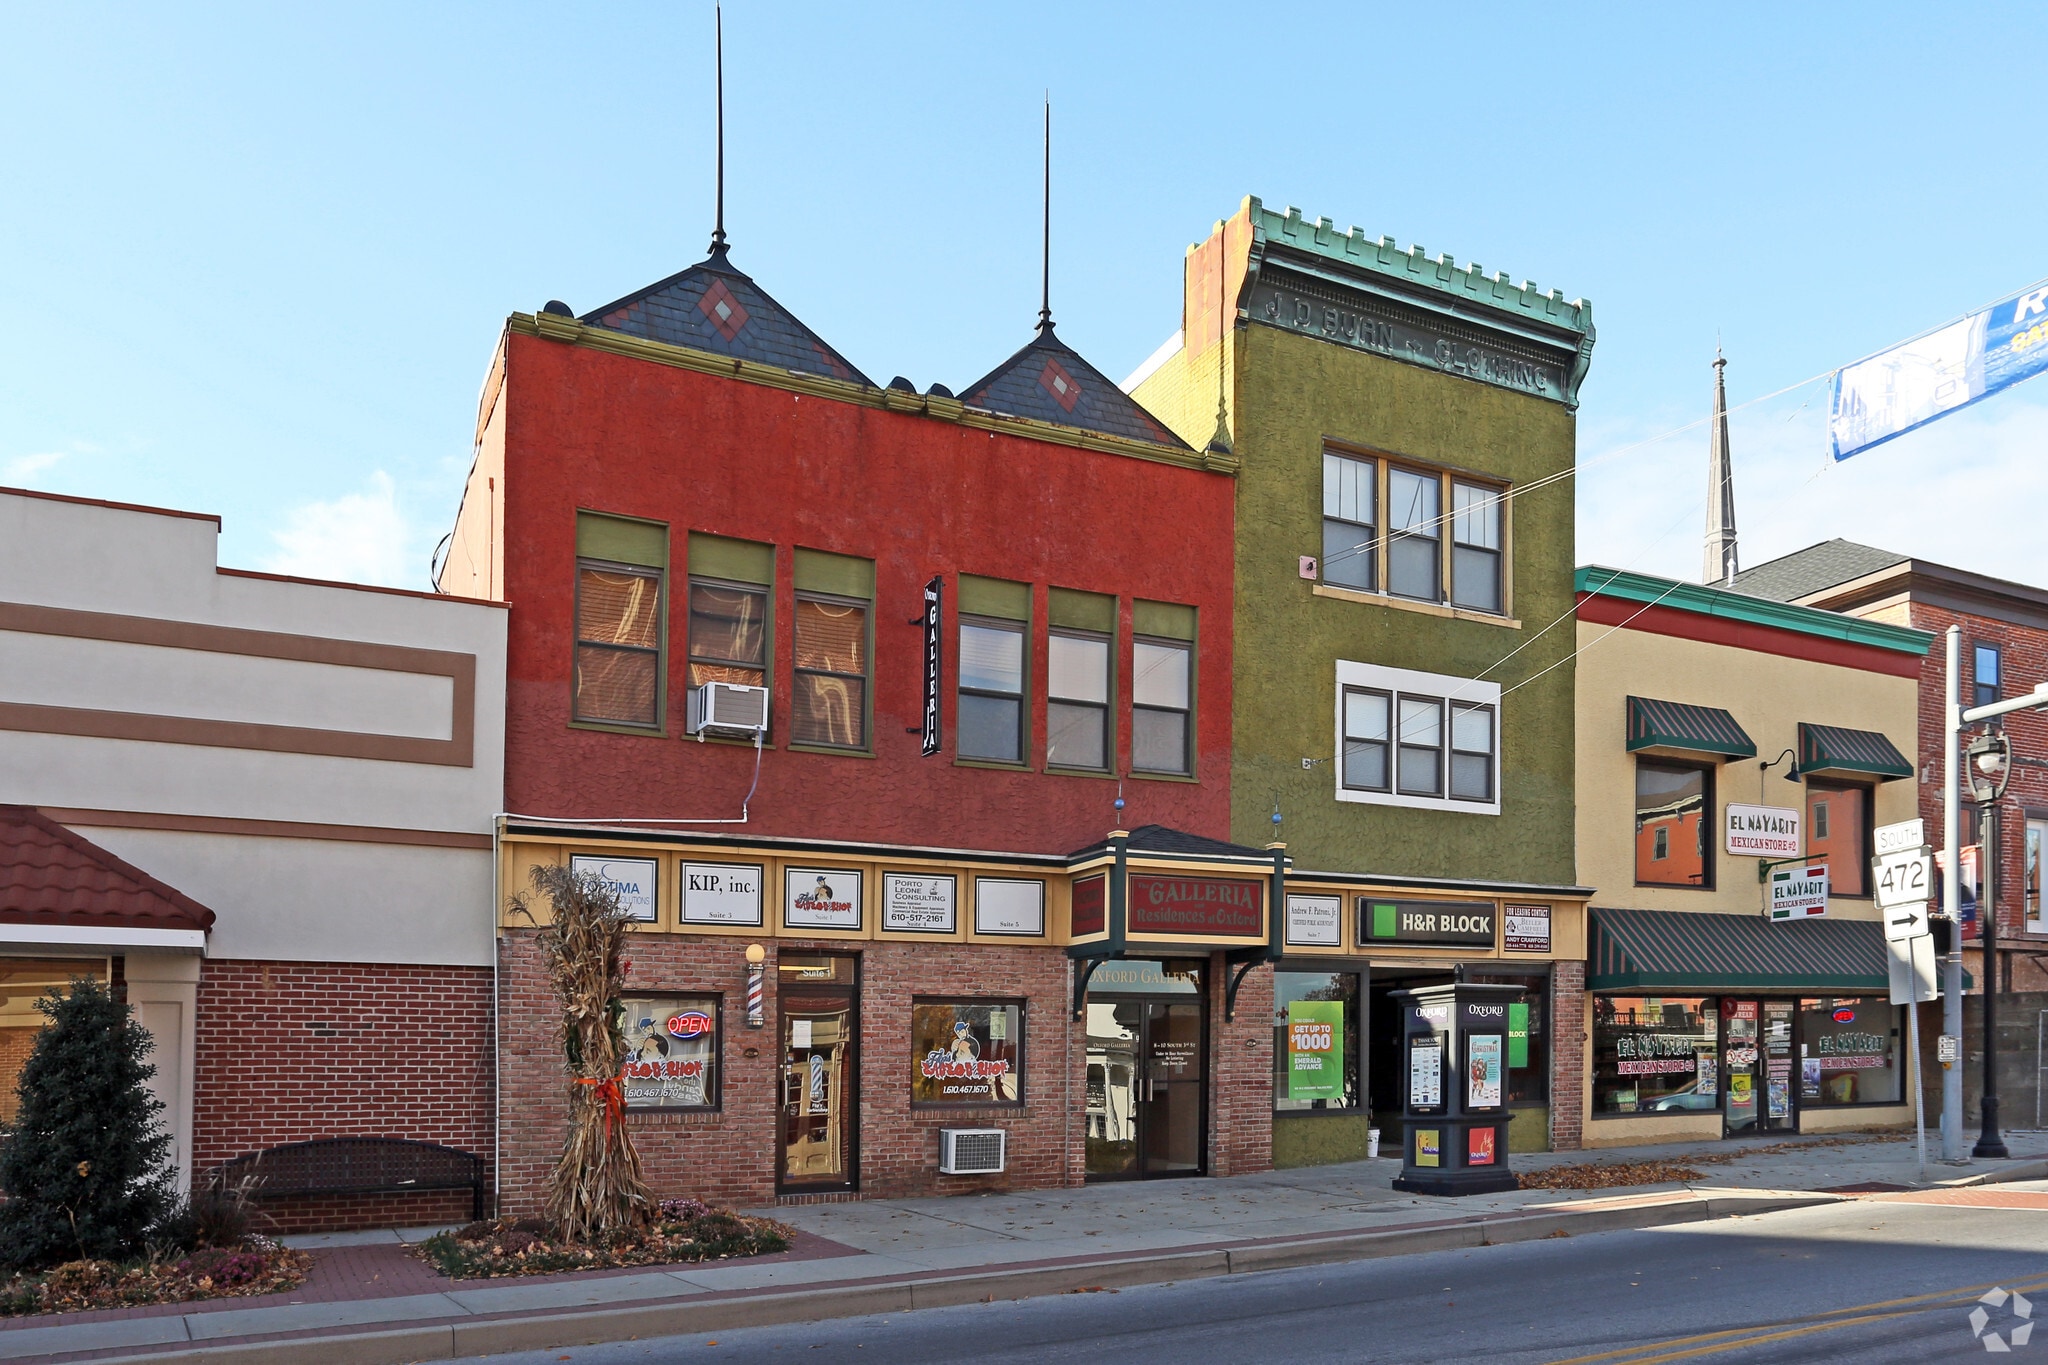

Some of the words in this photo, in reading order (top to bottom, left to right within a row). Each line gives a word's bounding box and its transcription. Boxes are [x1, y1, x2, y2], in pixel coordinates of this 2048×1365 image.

[1265, 292, 1282, 319] J
[1293, 297, 1312, 328] D
[1322, 305, 1393, 351] BURN
[1434, 338, 1548, 391] CLOTHING
[928, 605, 938, 749] GALLERIA
[1730, 815, 1745, 831] EL
[1748, 814, 1797, 834] NAYARIT
[1731, 836, 1764, 849] MEXICAN
[1764, 838, 1788, 851] STORE
[1788, 841, 1797, 852] #2
[1880, 828, 1919, 848] SOUTH
[689, 874, 723, 896] KIP,
[729, 876, 755, 893] inc.
[895, 879, 923, 888] PORTO
[1880, 861, 1925, 893] 472
[895, 892, 946, 902] CONSULTING
[1149, 881, 1254, 910] GALLERIA
[1774, 887, 1785, 899] EL
[1787, 881, 1823, 897] NAYARIT
[1773, 900, 1798, 909] MEXICAN
[1798, 898, 1817, 907] STORE
[891, 914, 943, 922] 610-517-2161
[1137, 907, 1205, 925] Residences
[1216, 908, 1257, 927] Oxford
[1402, 913, 1437, 932] H&R
[1440, 915, 1490, 934] BLOCK
[802, 969, 825, 978] Suite
[827, 969, 831, 977] 1
[1141, 968, 1201, 985] GALLERIA
[1415, 1006, 1448, 1018] OXFORD
[1468, 1004, 1504, 1017] OXFORD
[667, 1017, 711, 1033] OPEN
[1294, 1025, 1310, 1033] GET
[1310, 1025, 1320, 1033] UP
[1320, 1025, 1331, 1033] TO
[1617, 1038, 1635, 1057] EL
[1638, 1034, 1694, 1056] NAYARIT
[1819, 1036, 1834, 1053] EL
[1837, 1032, 1884, 1053] NAYARIT
[667, 1060, 704, 1078] SHOP
[977, 1060, 1009, 1078] SHOP
[1618, 1060, 1657, 1074] MEXICAN
[1657, 1060, 1685, 1073] STORE
[1820, 1057, 1852, 1069] MEXICAN
[1852, 1056, 1875, 1068] STORE
